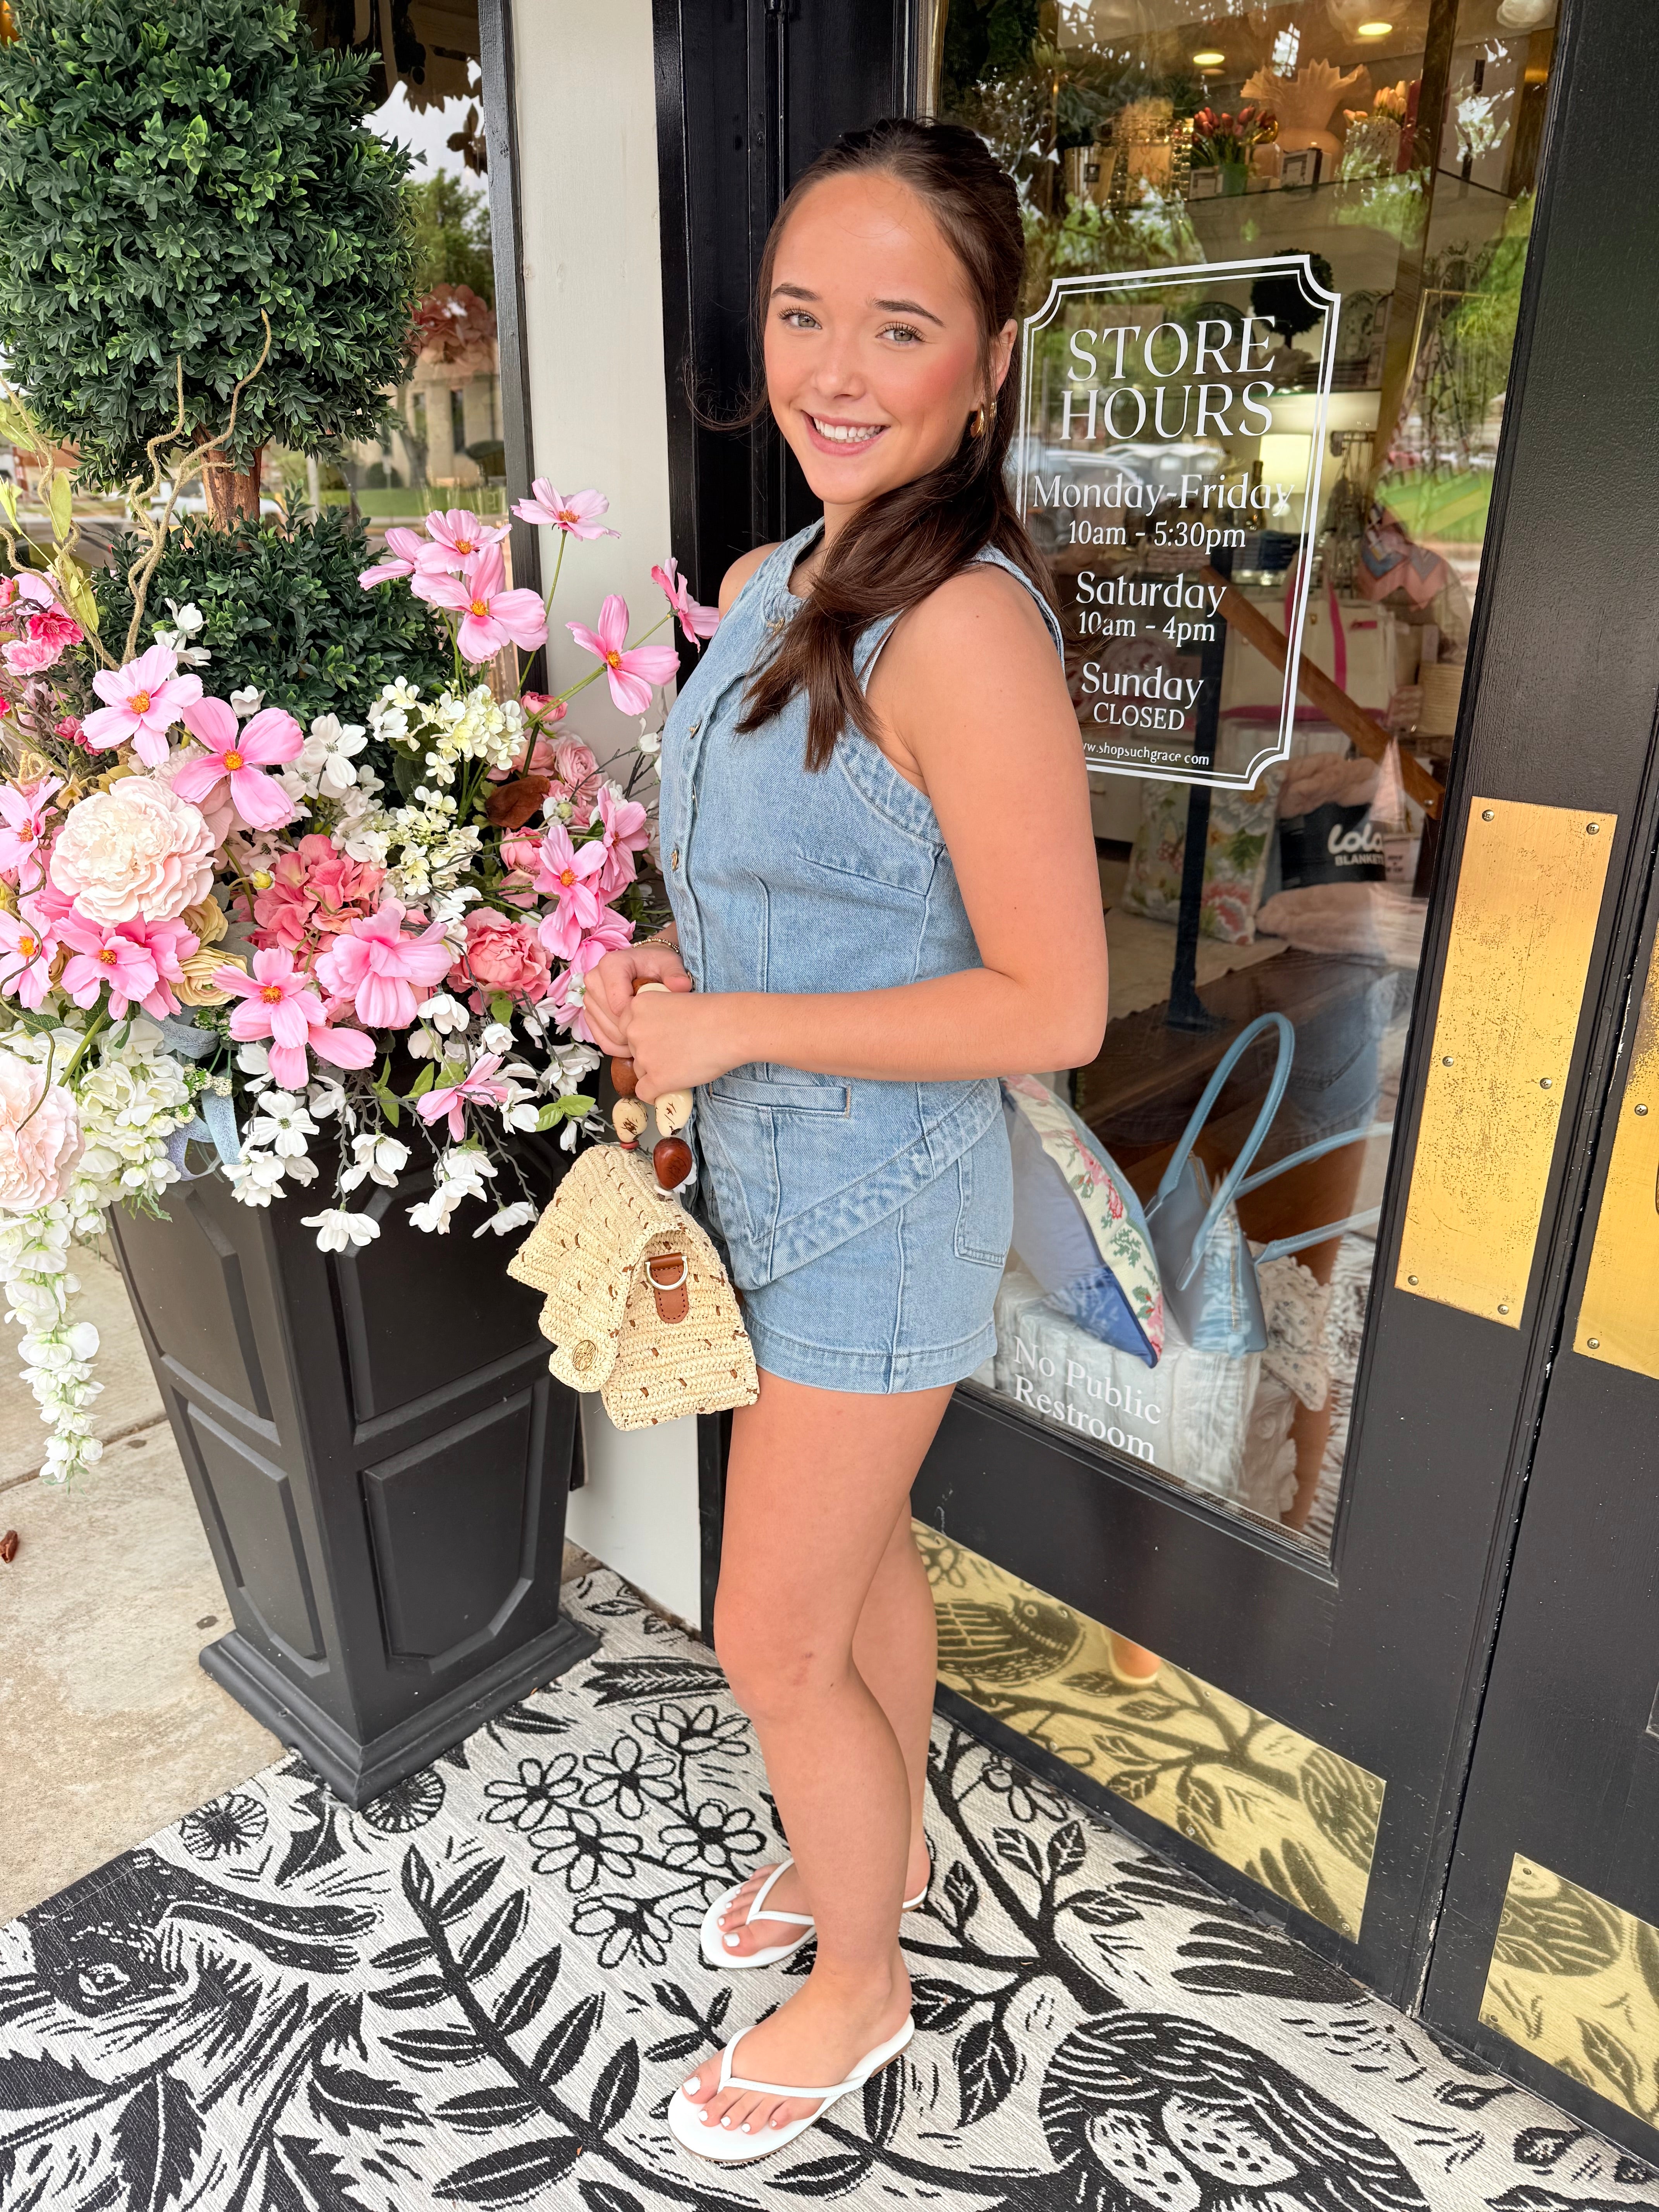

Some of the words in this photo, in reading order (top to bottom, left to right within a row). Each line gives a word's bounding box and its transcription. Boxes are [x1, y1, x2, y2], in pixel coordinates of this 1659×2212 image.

[1068, 316, 1276, 381] STORE
[1060, 381, 1274, 440] HOURS
[1033, 473, 1295, 517] Monday-Friday
[1069, 520, 1127, 545] 10am
[1154, 521, 1246, 555] 5:30pm
[1076, 572, 1227, 617] Saturday
[1079, 611, 1136, 636] 10am
[1163, 616, 1215, 647] 4pm
[1082, 662, 1204, 709] Sunday
[1094, 702, 1185, 730] CLOSED
[1014, 1336, 1055, 1377] No
[1065, 1359, 1161, 1424] Public
[1014, 1374, 1156, 1463] Restroom
